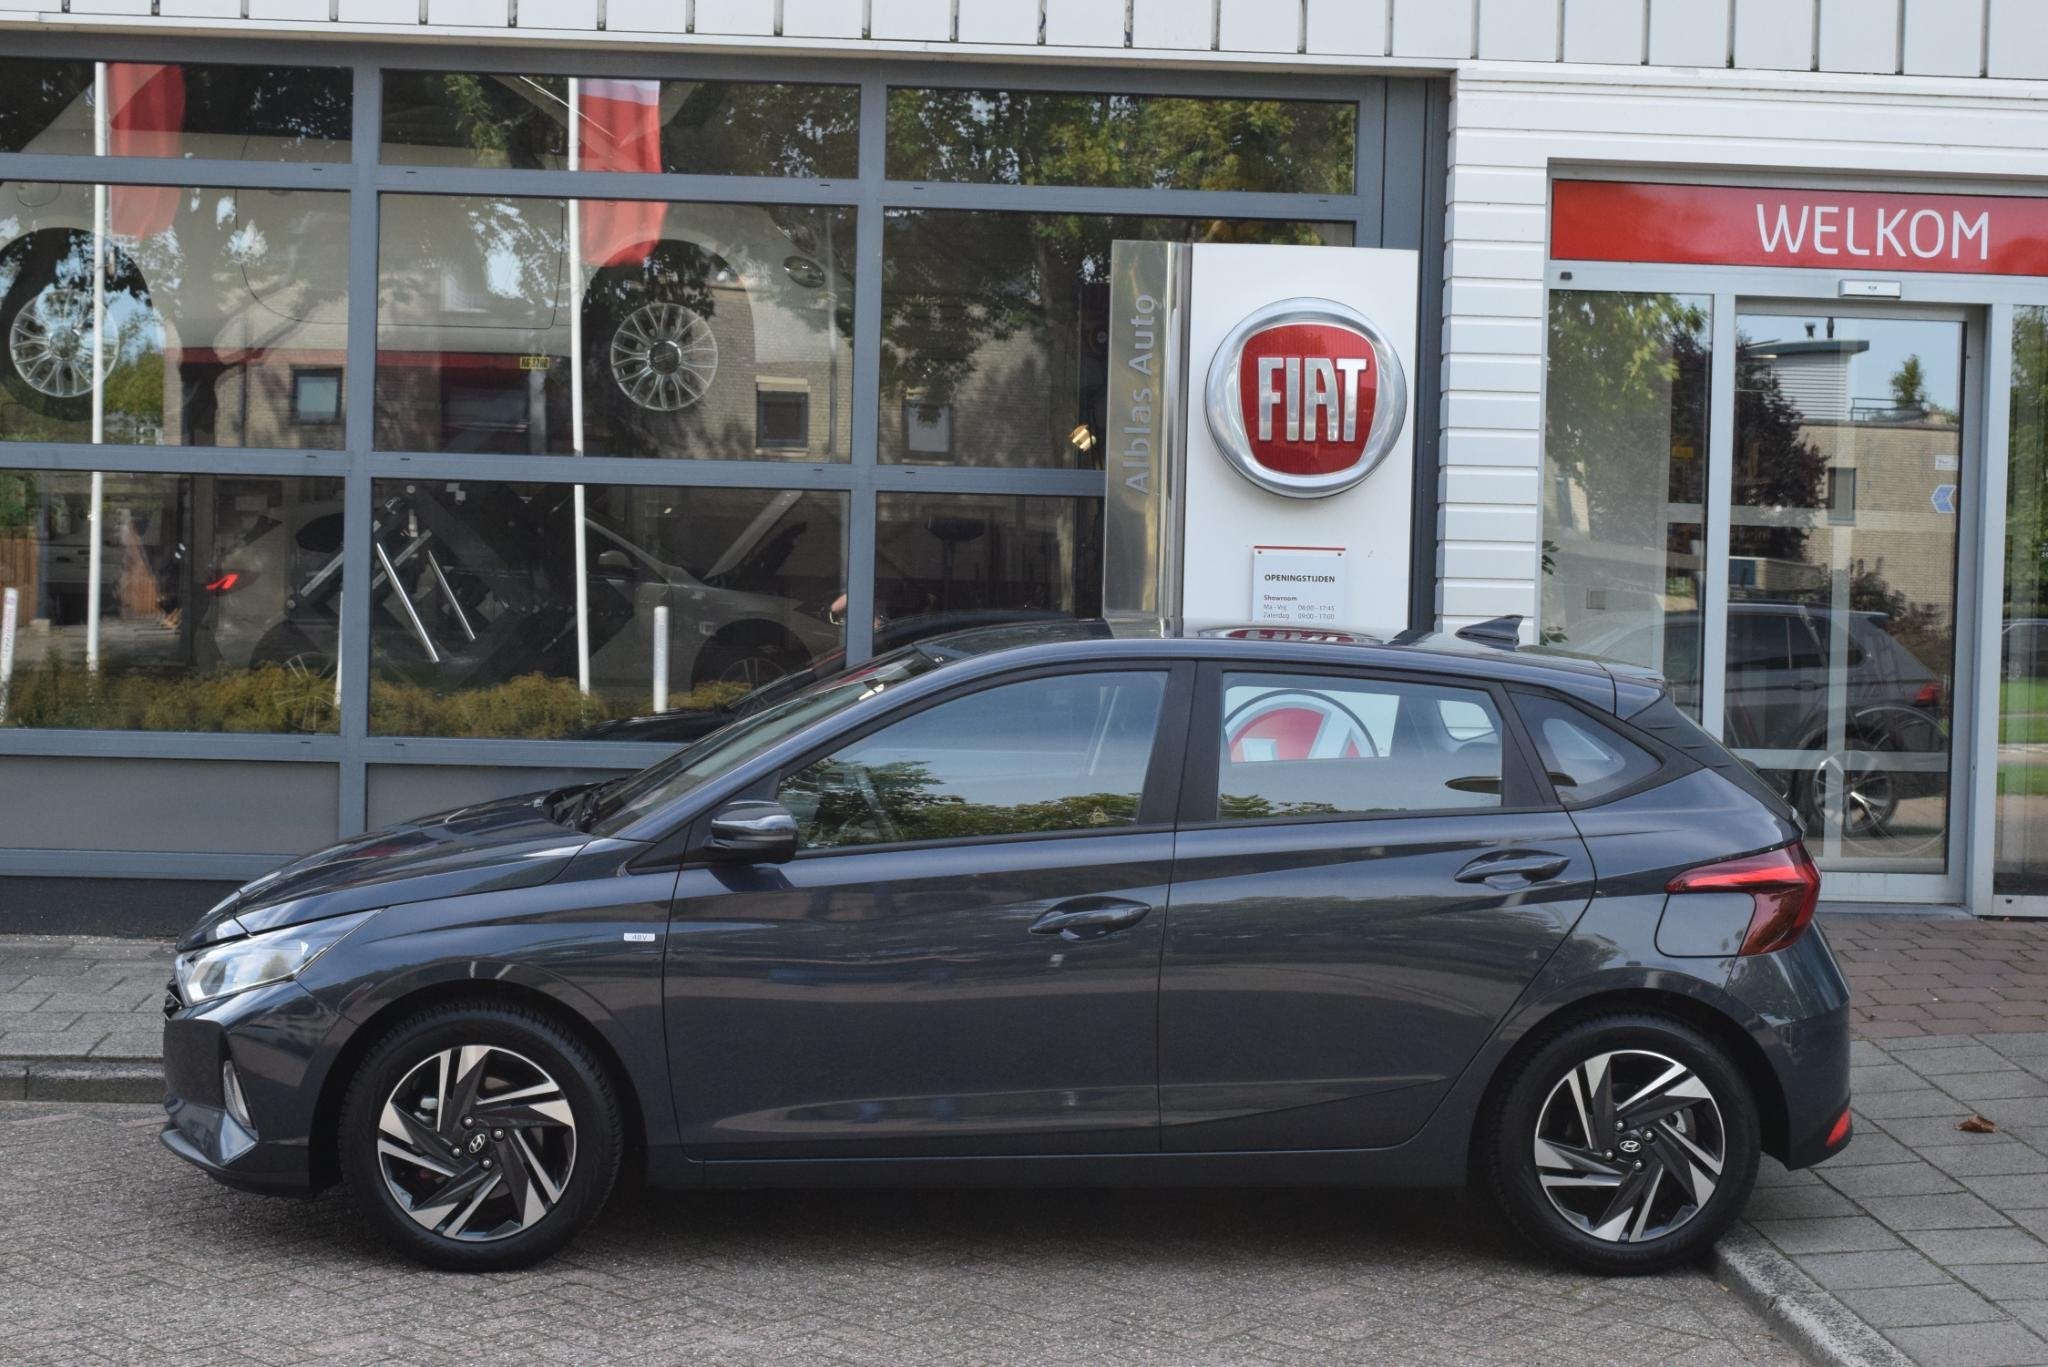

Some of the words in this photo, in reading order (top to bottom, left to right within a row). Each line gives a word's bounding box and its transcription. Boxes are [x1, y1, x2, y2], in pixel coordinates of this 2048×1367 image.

[1756, 203, 1989, 260] WELKOM
[1129, 293, 1156, 377] Auto
[1258, 357, 1367, 442] FIAT
[1125, 388, 1152, 495] Alblas
[1263, 594, 1297, 602] Showroom
[1264, 574, 1336, 583] OPENINGSTIJDEN
